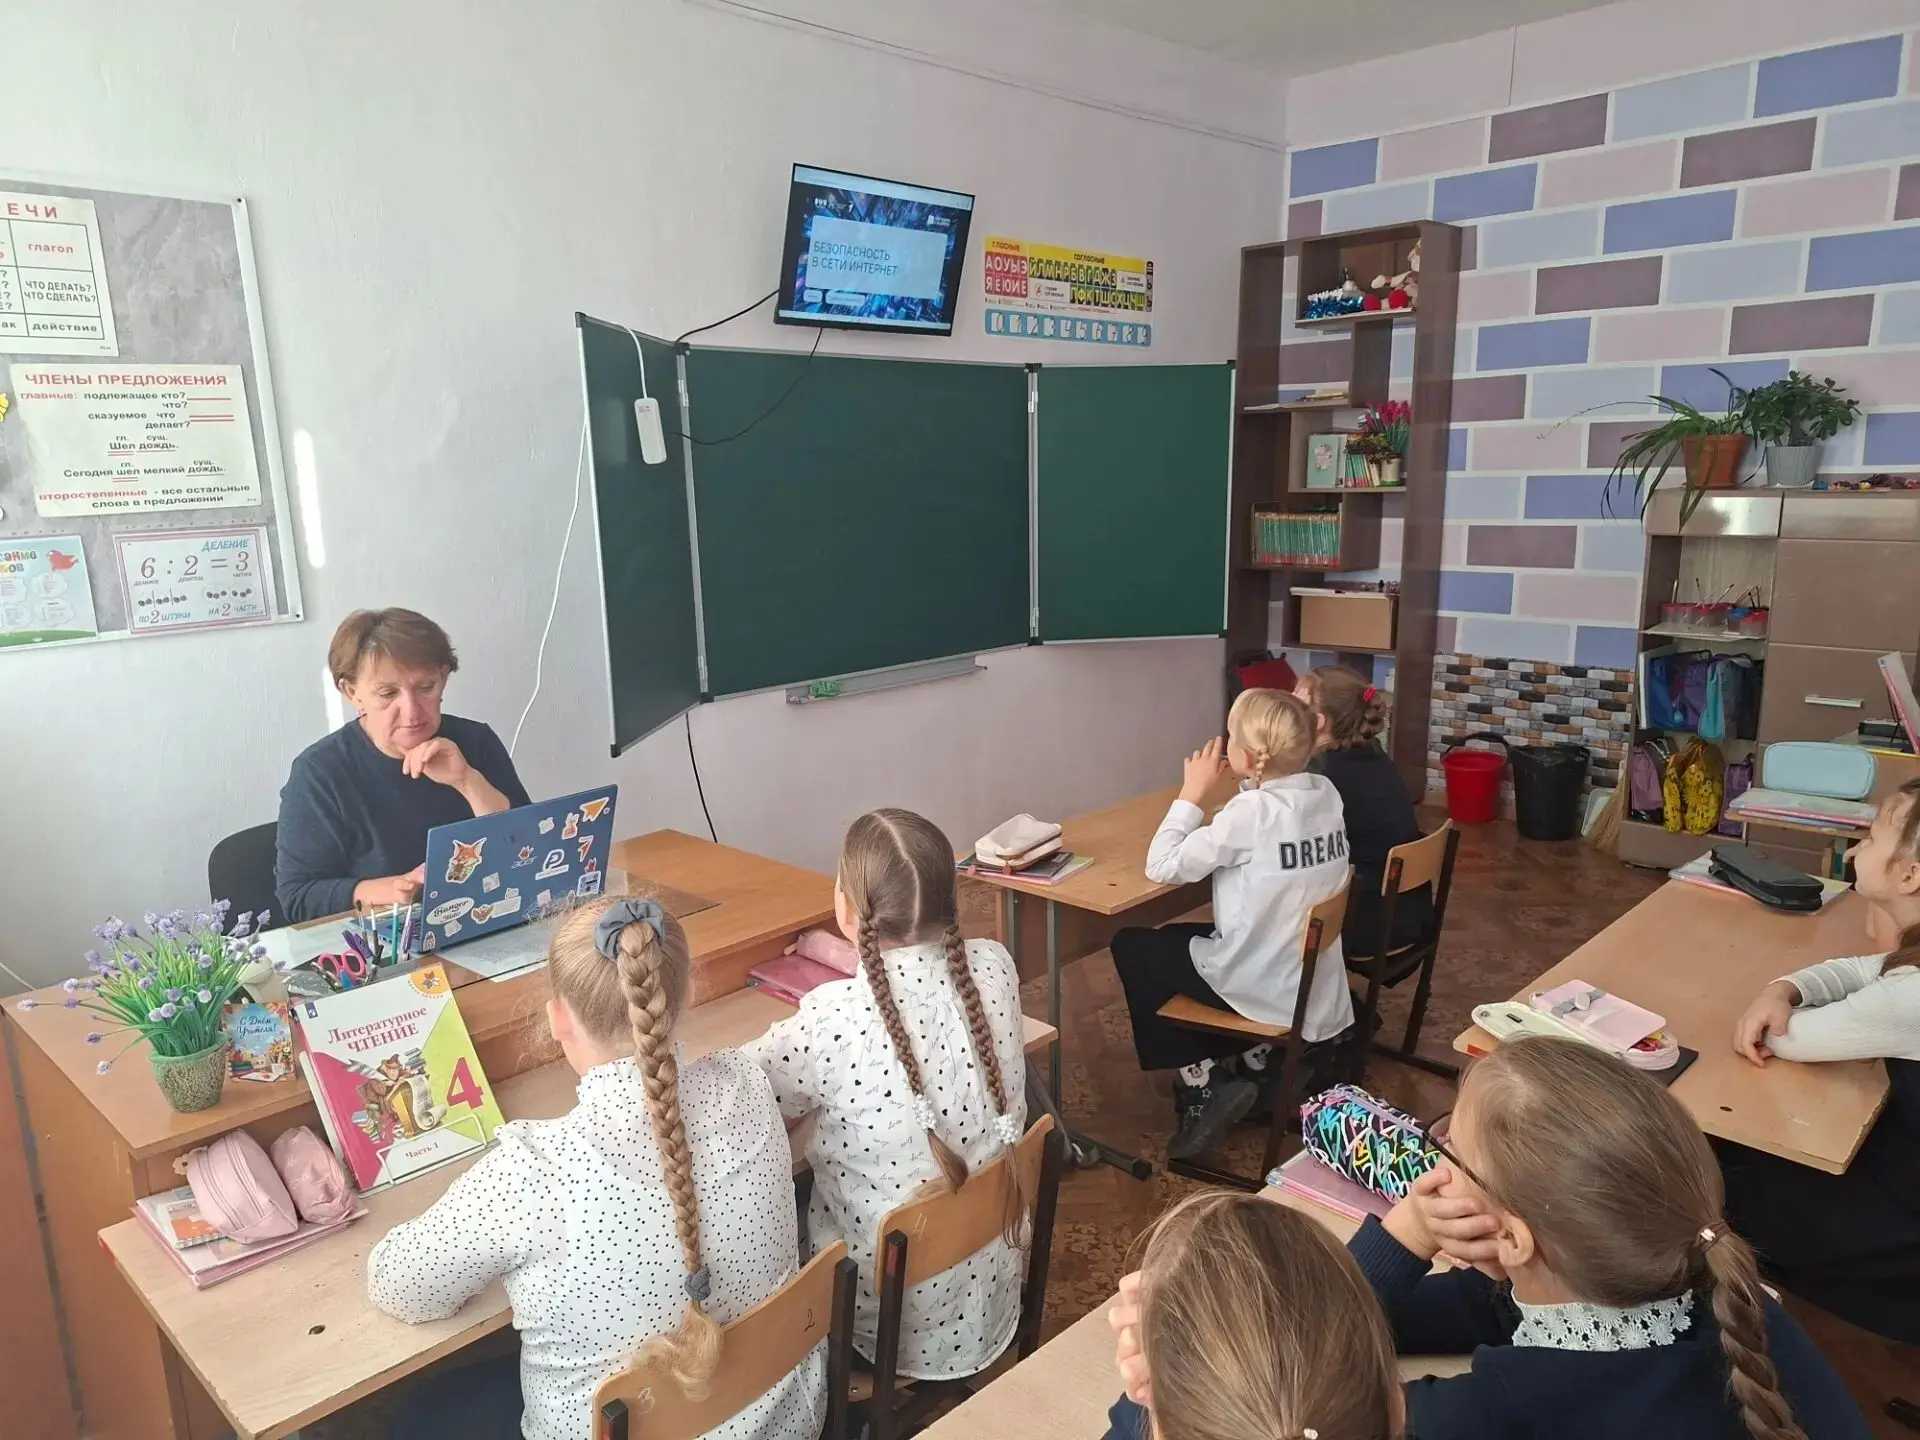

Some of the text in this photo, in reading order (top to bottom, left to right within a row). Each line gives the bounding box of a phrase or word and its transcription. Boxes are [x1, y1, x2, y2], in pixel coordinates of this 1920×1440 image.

[28, 243, 74, 254] глагол
[814, 241, 891, 261] БЕЗОПАСНОСТЬ
[812, 257, 898, 276] В СЕТИ ИНТЕРНЕТ
[25, 280, 91, 292] ЧТО ДЕЛАТЬ?
[24, 291, 96, 303] ЧТО СДЕЛАТЬ?
[32, 321, 97, 332] действие
[25, 374, 227, 387] ЧЛЕНЫ ПРЕДЛОЖЕНИЯ
[20, 391, 186, 401] главные: подлежащее кто?
[162, 401, 188, 409] что?
[88, 412, 147, 421] сказуемое
[145, 420, 191, 430] делает?
[109, 442, 179, 450] Шел дождь.
[63, 465, 227, 479] Сегодня шел мелкий дождь.
[39, 488, 148, 501] второстепенные
[162, 487, 183, 496] все
[186, 484, 250, 495] остальные
[92, 500, 130, 508] слова
[143, 496, 224, 507] предложении
[201, 539, 249, 552] ДЕЛЕНИЕ
[140, 557, 156, 579] 6
[184, 555, 199, 576] 2
[235, 551, 250, 572] 3
[208, 608, 220, 617] НА
[221, 603, 231, 617] 2
[138, 610, 191, 624] ПО 2 ШТУКИ
[328, 1007, 427, 1044] Литературное
[347, 1022, 419, 1052] ЧТЕНИЕ
[446, 1056, 484, 1110] 4
[405, 1146, 433, 1158] Часть
[804, 1308, 815, 1332] 2
